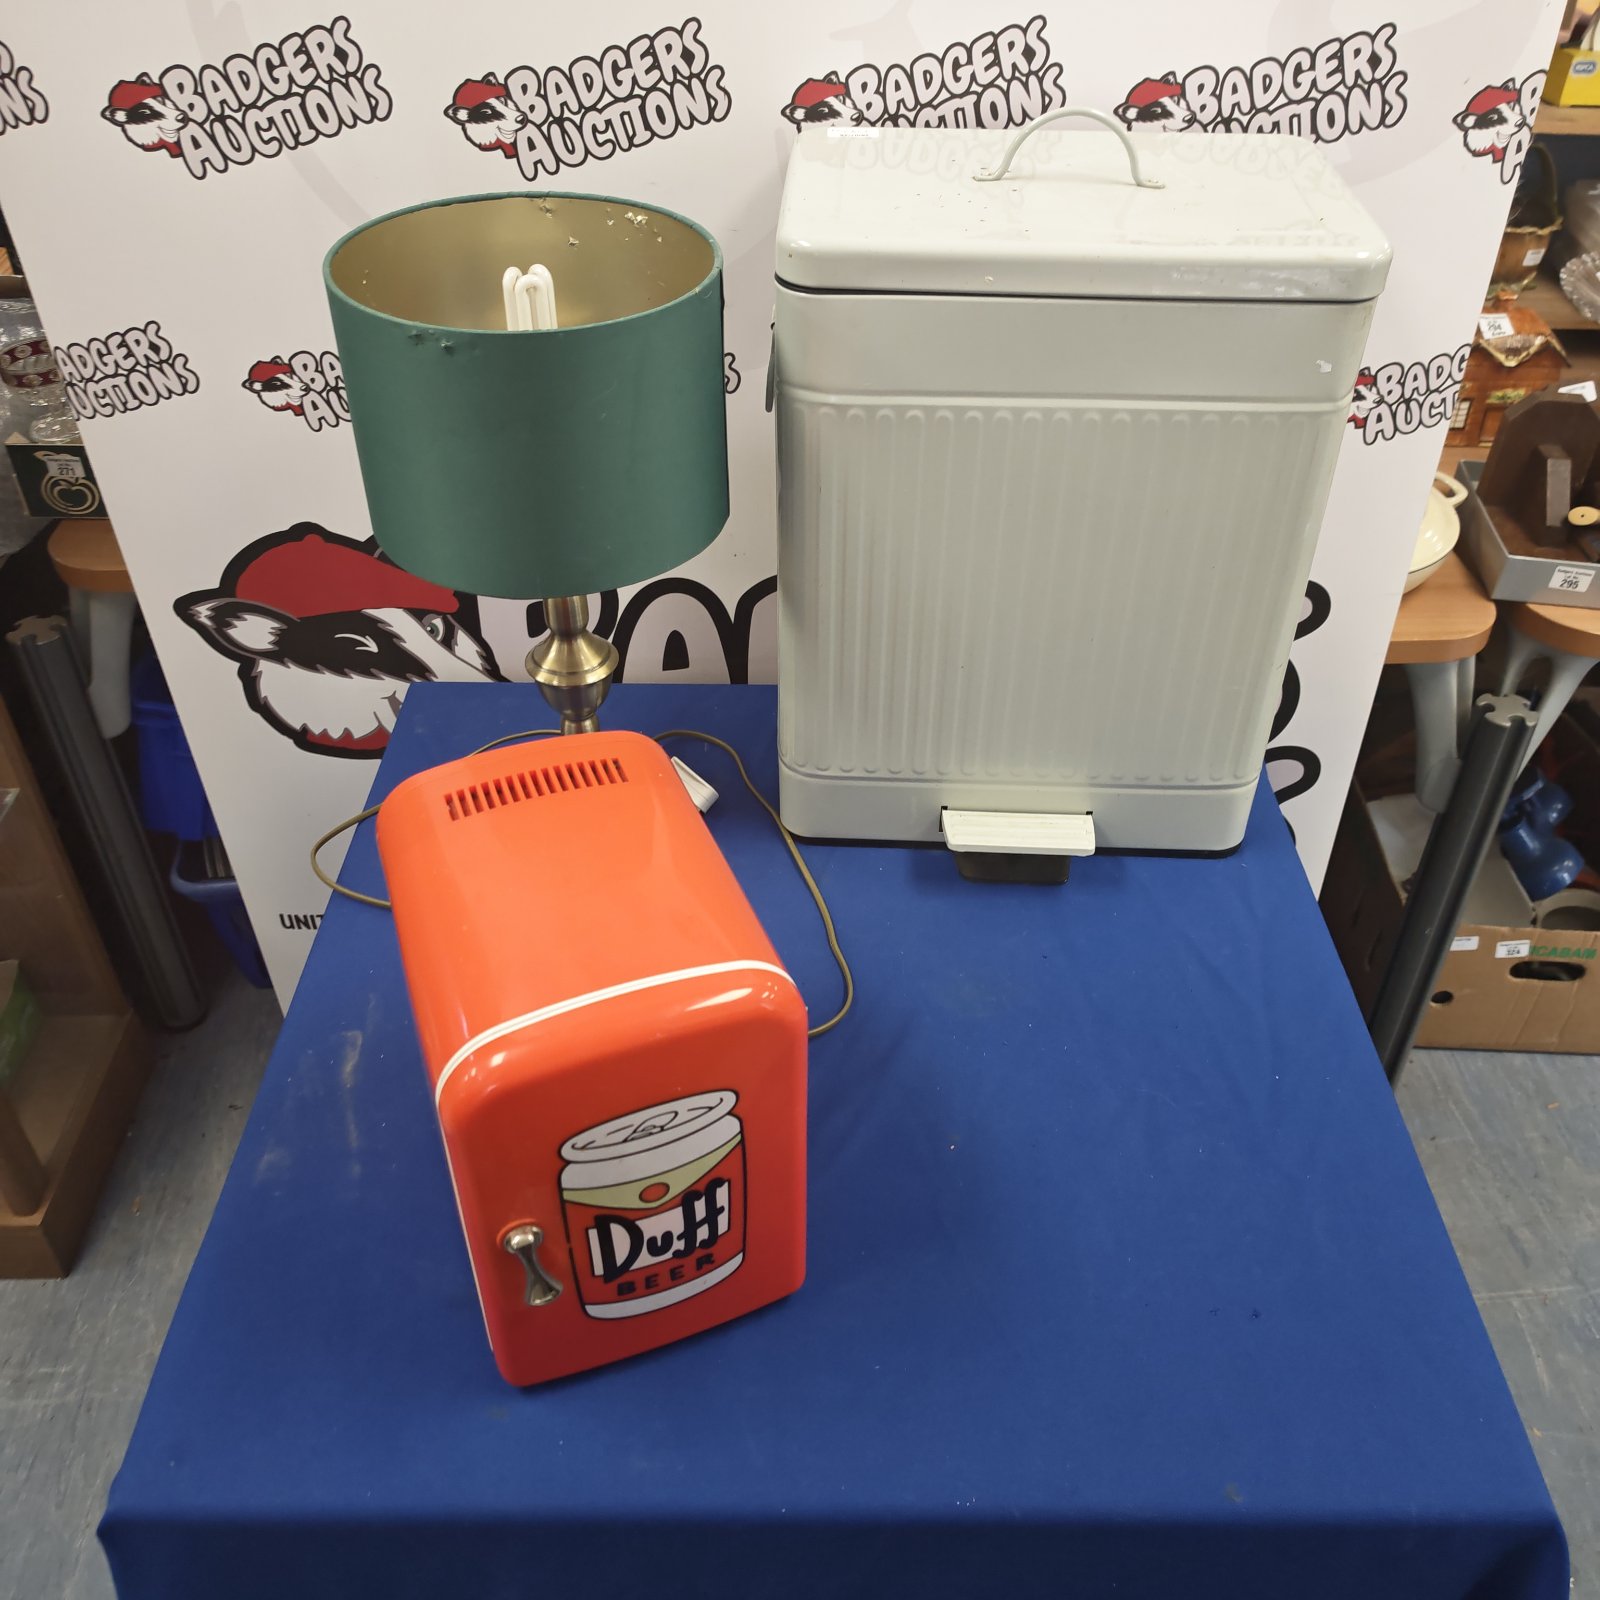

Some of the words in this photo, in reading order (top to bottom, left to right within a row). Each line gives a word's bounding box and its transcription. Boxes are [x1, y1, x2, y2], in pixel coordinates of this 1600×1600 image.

[159, 15, 363, 125] BADGERS
[180, 63, 393, 180] AUCTIONS
[504, 17, 709, 126] BADGERS
[845, 14, 1051, 123] BADGERS
[1182, 22, 1397, 126] BADGERS
[516, 64, 732, 182] AUCTIONS
[65, 353, 200, 421] UCTIONS
[1559, 579, 1580, 589] 295
[595, 1177, 726, 1284] Duff
[617, 1253, 715, 1296] BEER
